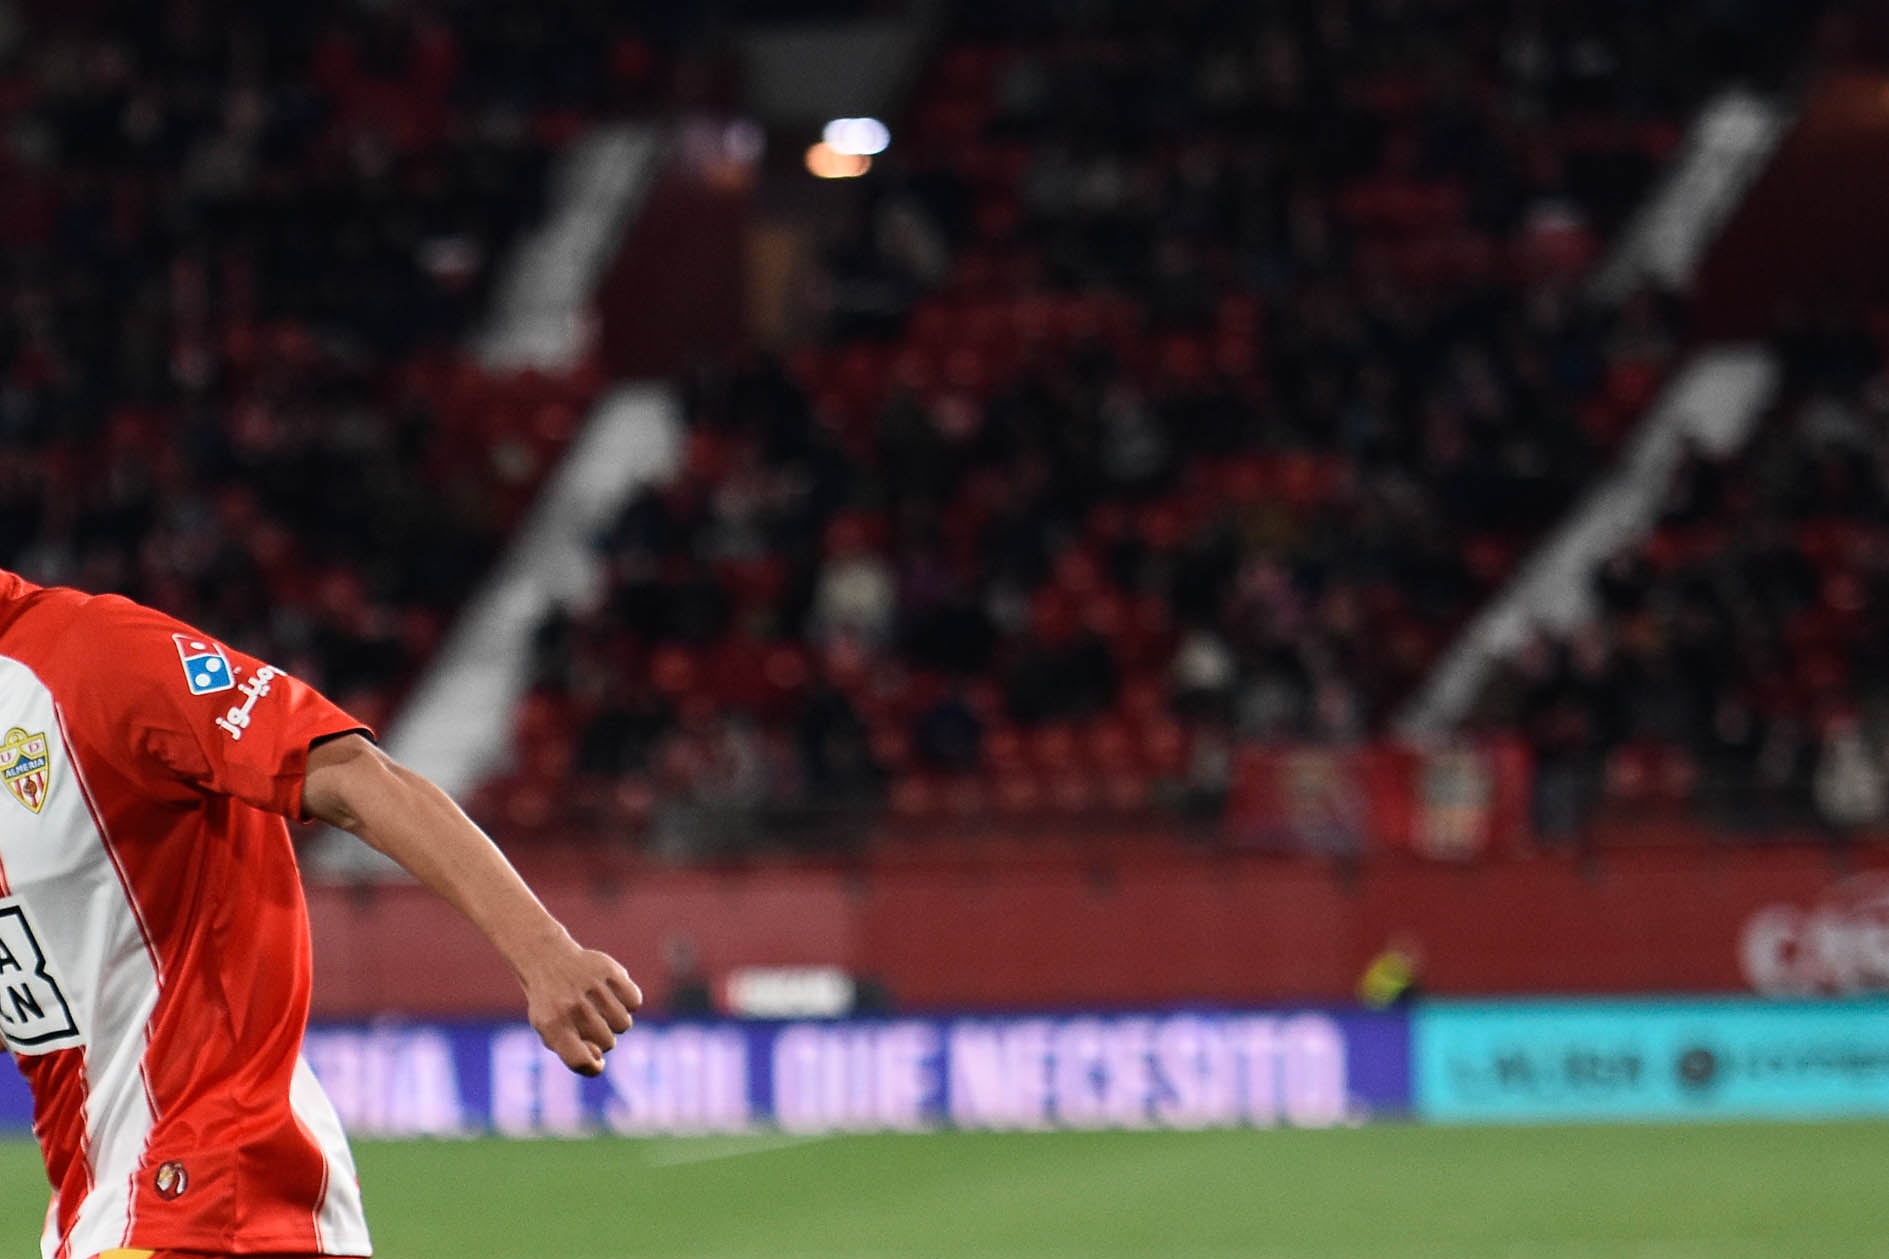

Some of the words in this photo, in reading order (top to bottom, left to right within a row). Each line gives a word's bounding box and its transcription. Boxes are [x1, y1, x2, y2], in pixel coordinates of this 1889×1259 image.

[0, 752, 12, 763] U
[28, 741, 40, 753] D
[948, 1012, 1346, 1131] NECESITO
